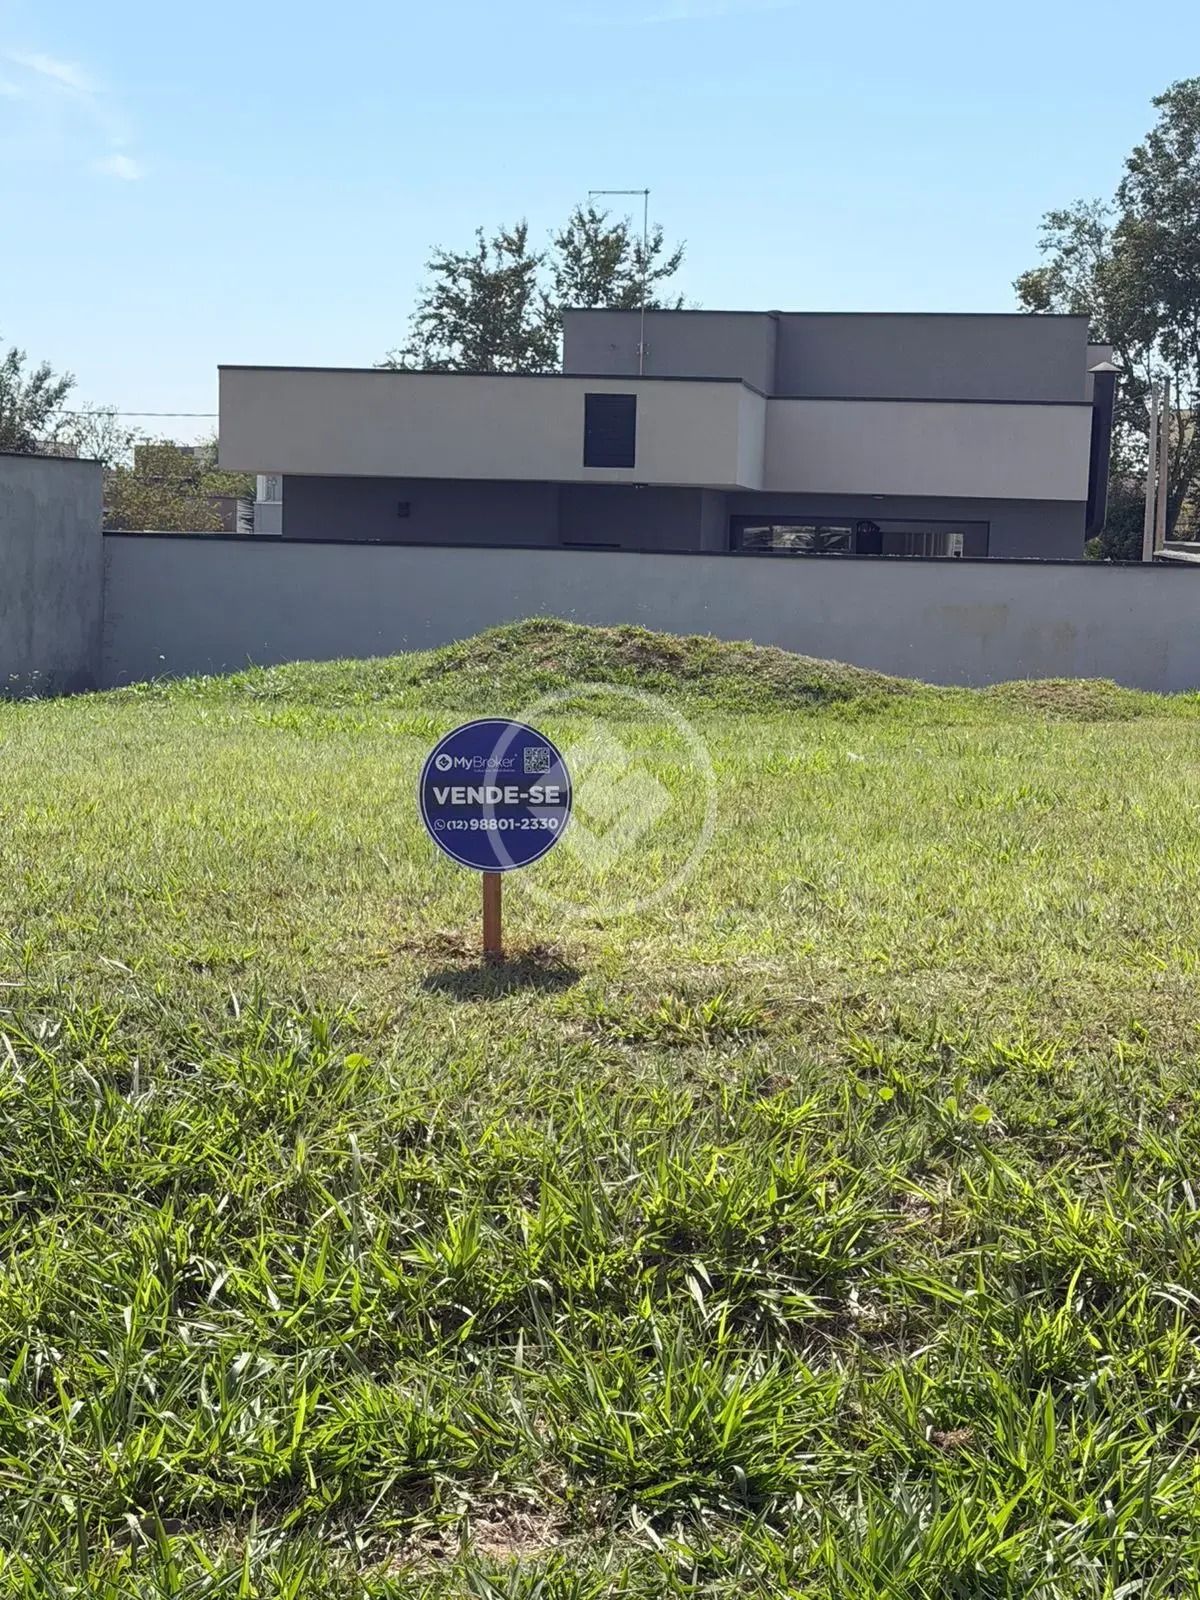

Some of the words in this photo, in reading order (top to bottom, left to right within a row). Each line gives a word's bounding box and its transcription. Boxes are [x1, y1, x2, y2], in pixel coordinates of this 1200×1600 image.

[454, 755, 516, 770] MyBroker
[433, 786, 560, 805] VENDE-SE
[446, 819, 468, 831] (12)
[470, 818, 558, 831] 98801-2330
